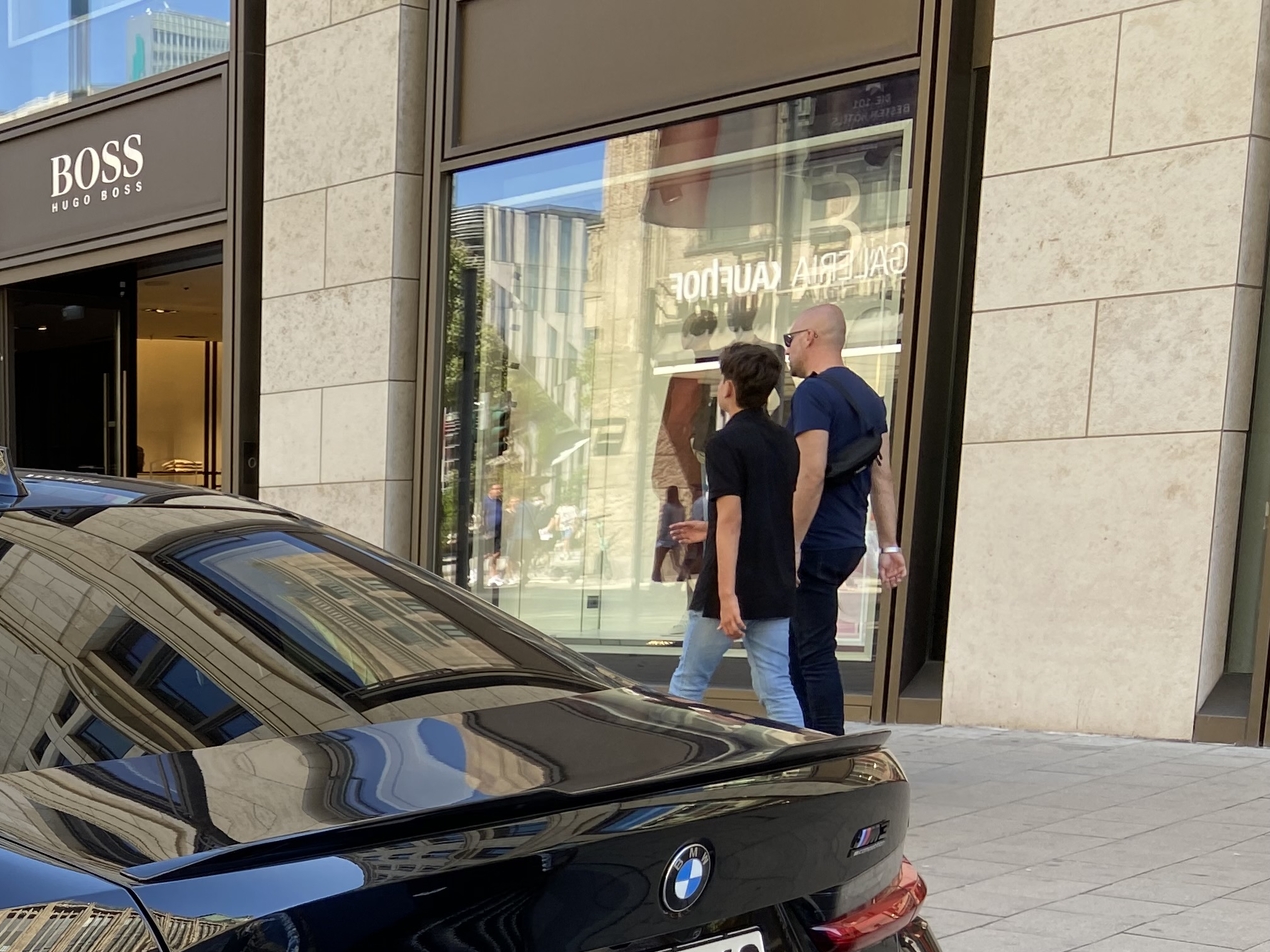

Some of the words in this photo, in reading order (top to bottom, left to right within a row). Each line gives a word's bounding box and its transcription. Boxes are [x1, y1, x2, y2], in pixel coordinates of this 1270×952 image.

[50, 134, 144, 198] BOSS
[51, 194, 91, 213] HUGO
[101, 181, 143, 201] BOSS
[674, 847, 709, 871] BMW
